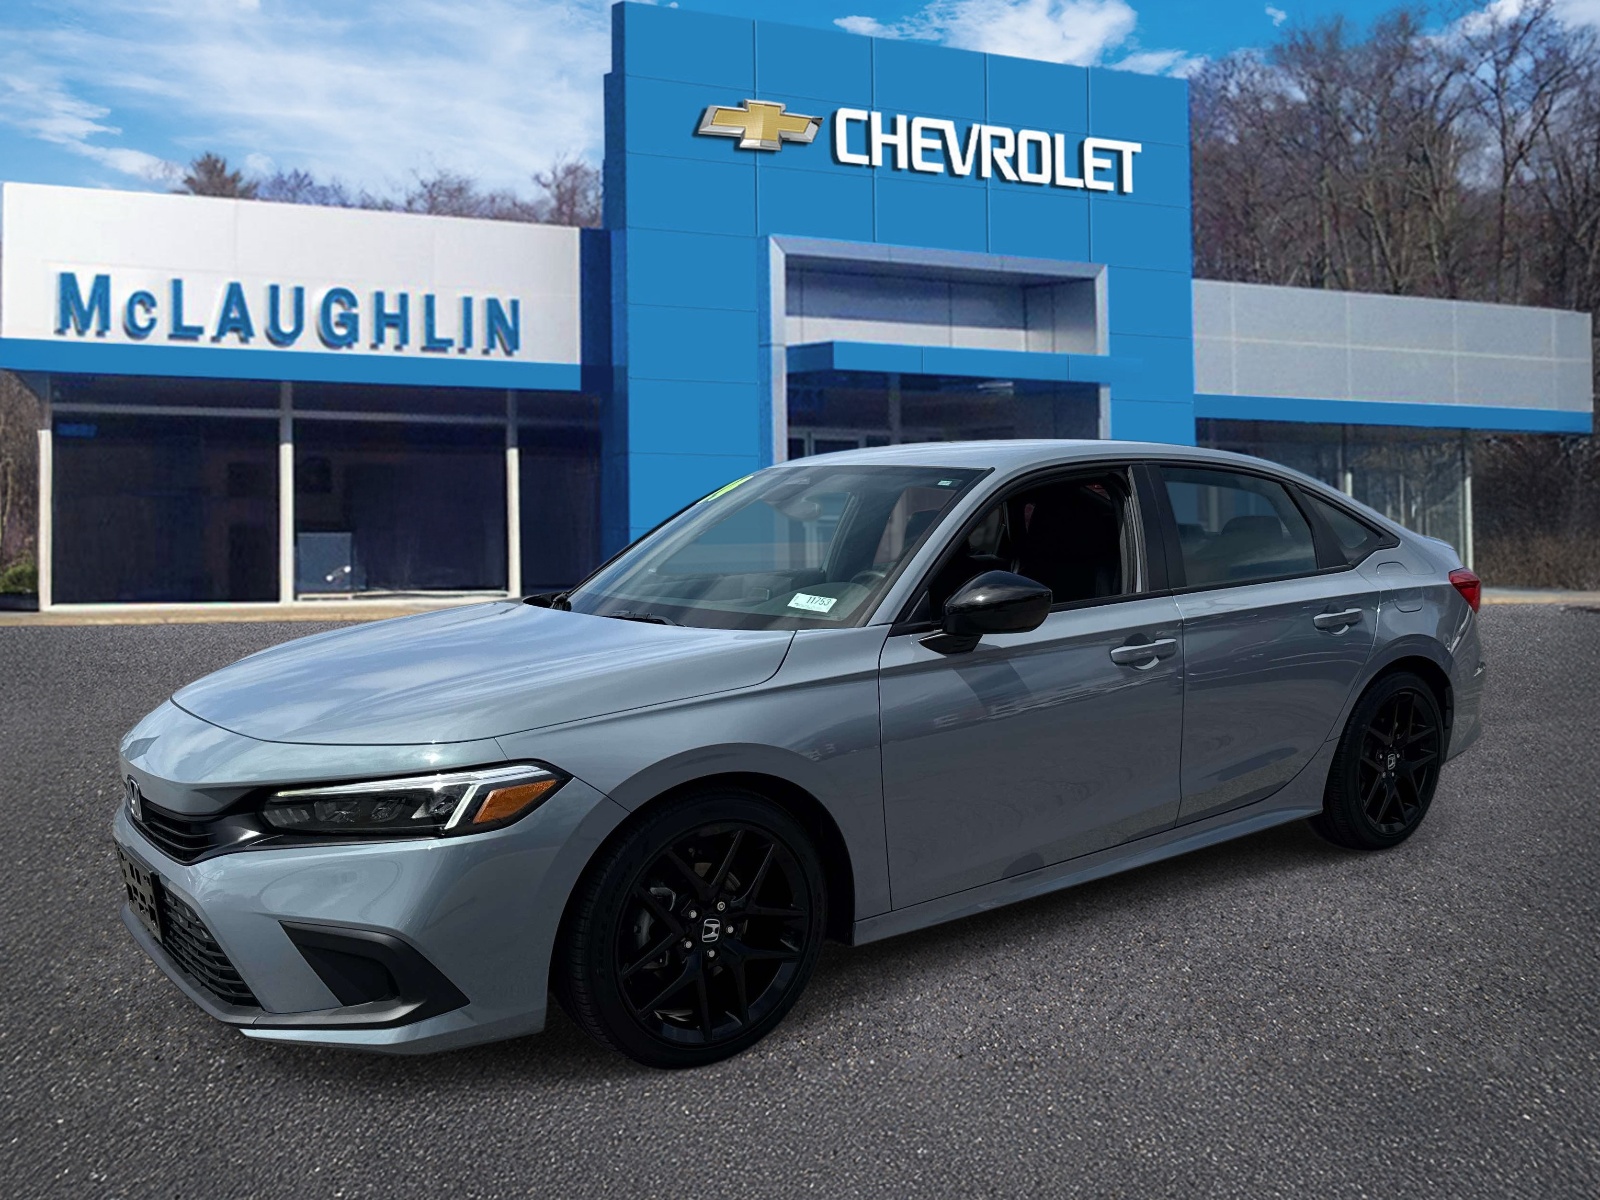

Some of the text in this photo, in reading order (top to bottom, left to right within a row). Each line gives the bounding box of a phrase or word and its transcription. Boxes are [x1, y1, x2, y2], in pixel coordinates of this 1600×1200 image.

[835, 107, 1142, 193] CHEVROLET
[55, 272, 521, 357] McLAUGHLIN
[806, 596, 832, 606] 11753
